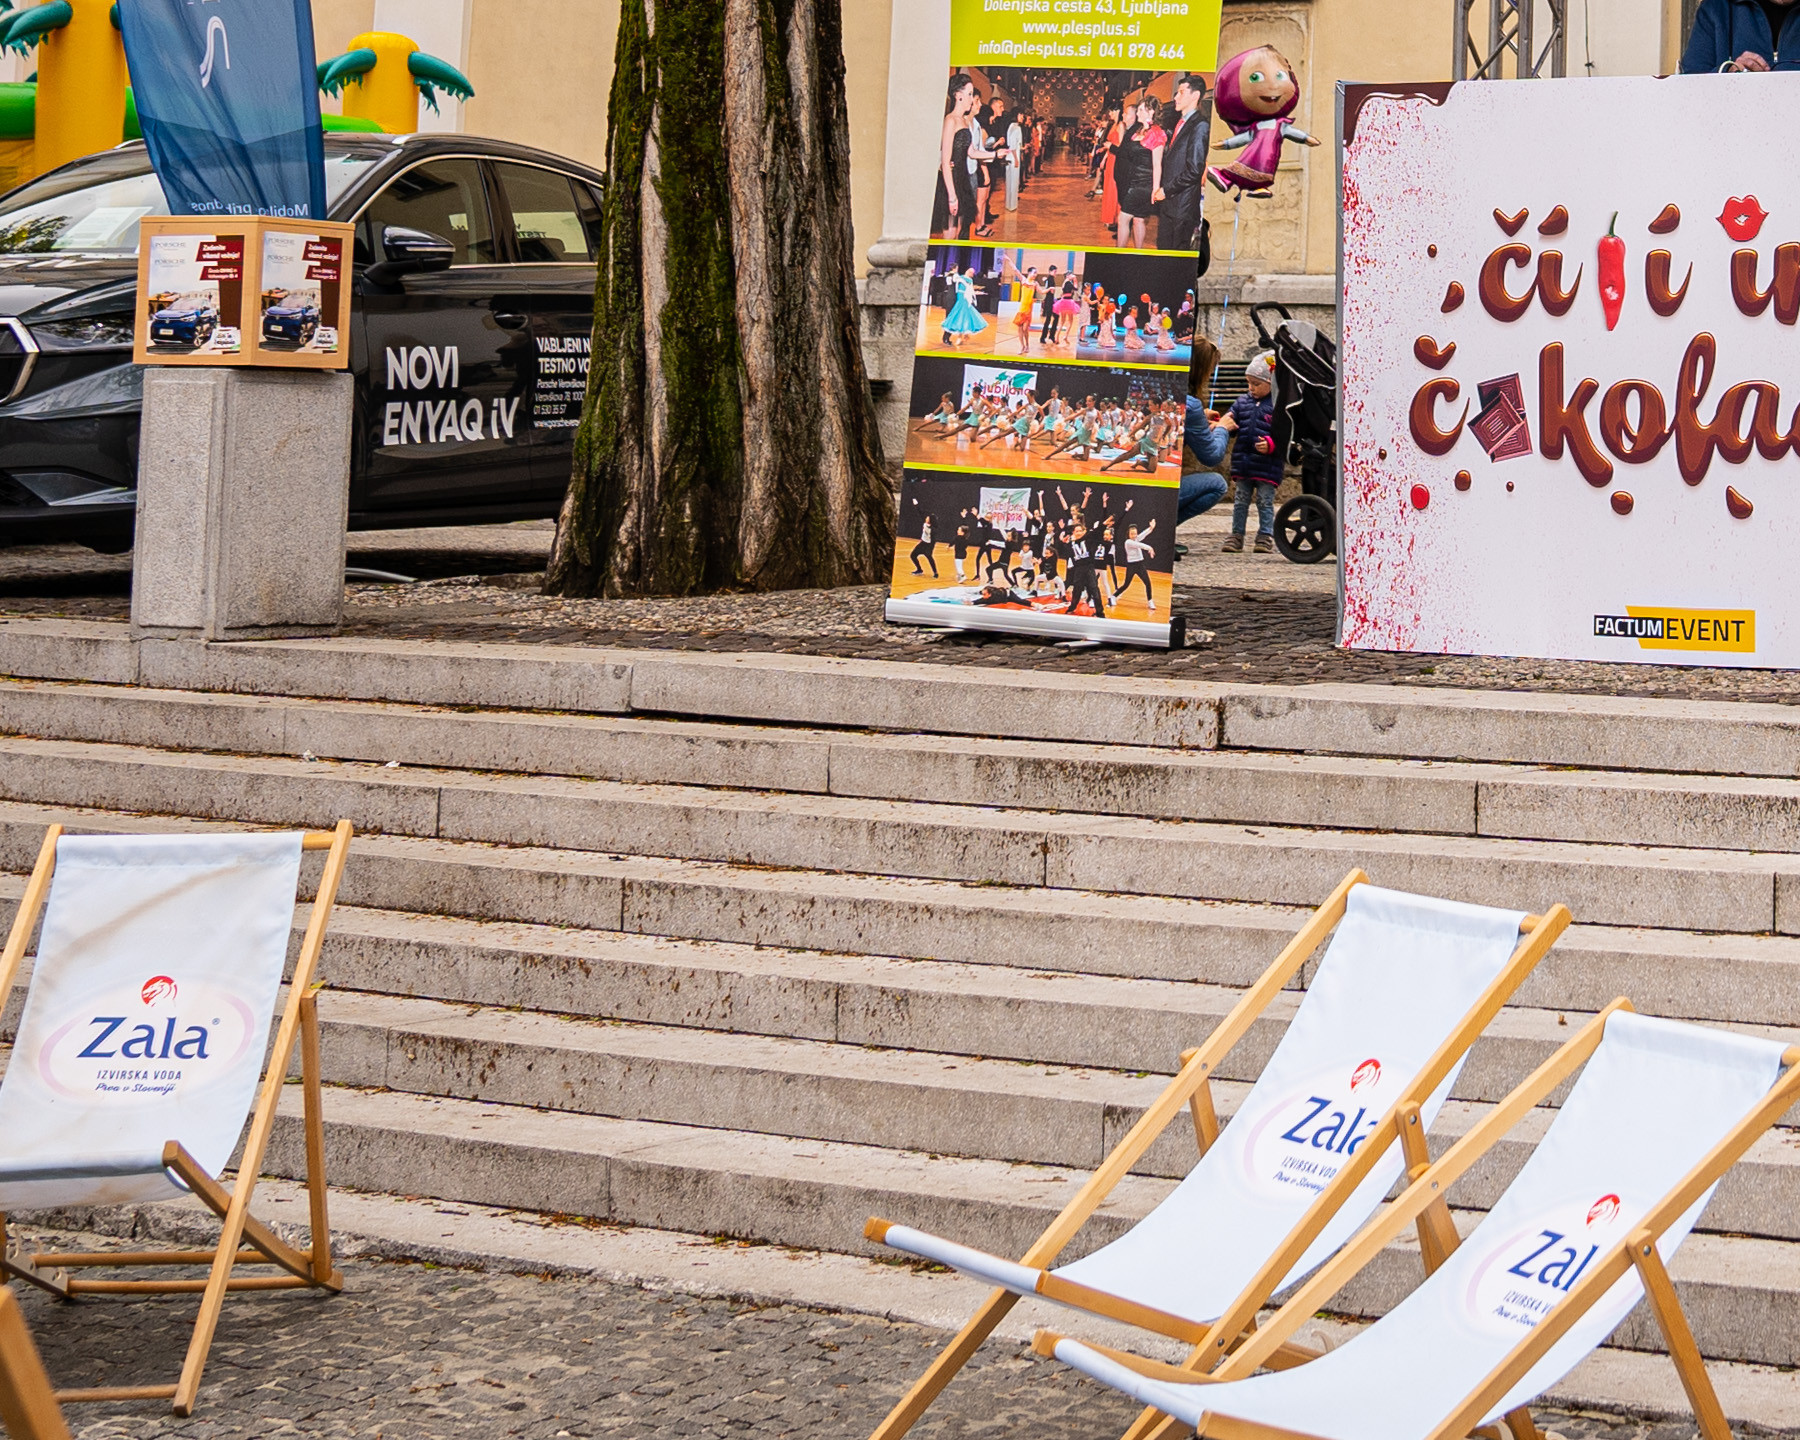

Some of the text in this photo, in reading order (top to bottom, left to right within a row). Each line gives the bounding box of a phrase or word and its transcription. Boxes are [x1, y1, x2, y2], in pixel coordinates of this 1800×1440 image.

[1053, 1, 1092, 14] cesta
[1120, 0, 1189, 19] Ljubljana
[1023, 20, 1141, 39] www.plesplus.si
[978, 40, 1186, 60] info@plesplus.si 041 878 464
[536, 337, 592, 353] VABLJENI N
[386, 346, 459, 390] NOVI
[538, 358, 576, 373] TESTNO
[383, 397, 521, 446] ENYAQ iV
[76, 1016, 209, 1060] Zala
[97, 1070, 182, 1080] IZVIRSKA VODA
[1281, 1156, 1337, 1179] IZVIRSKA VOD
[1507, 1229, 1600, 1292] Zal
[1504, 1290, 1542, 1311] IZVIRSKA
